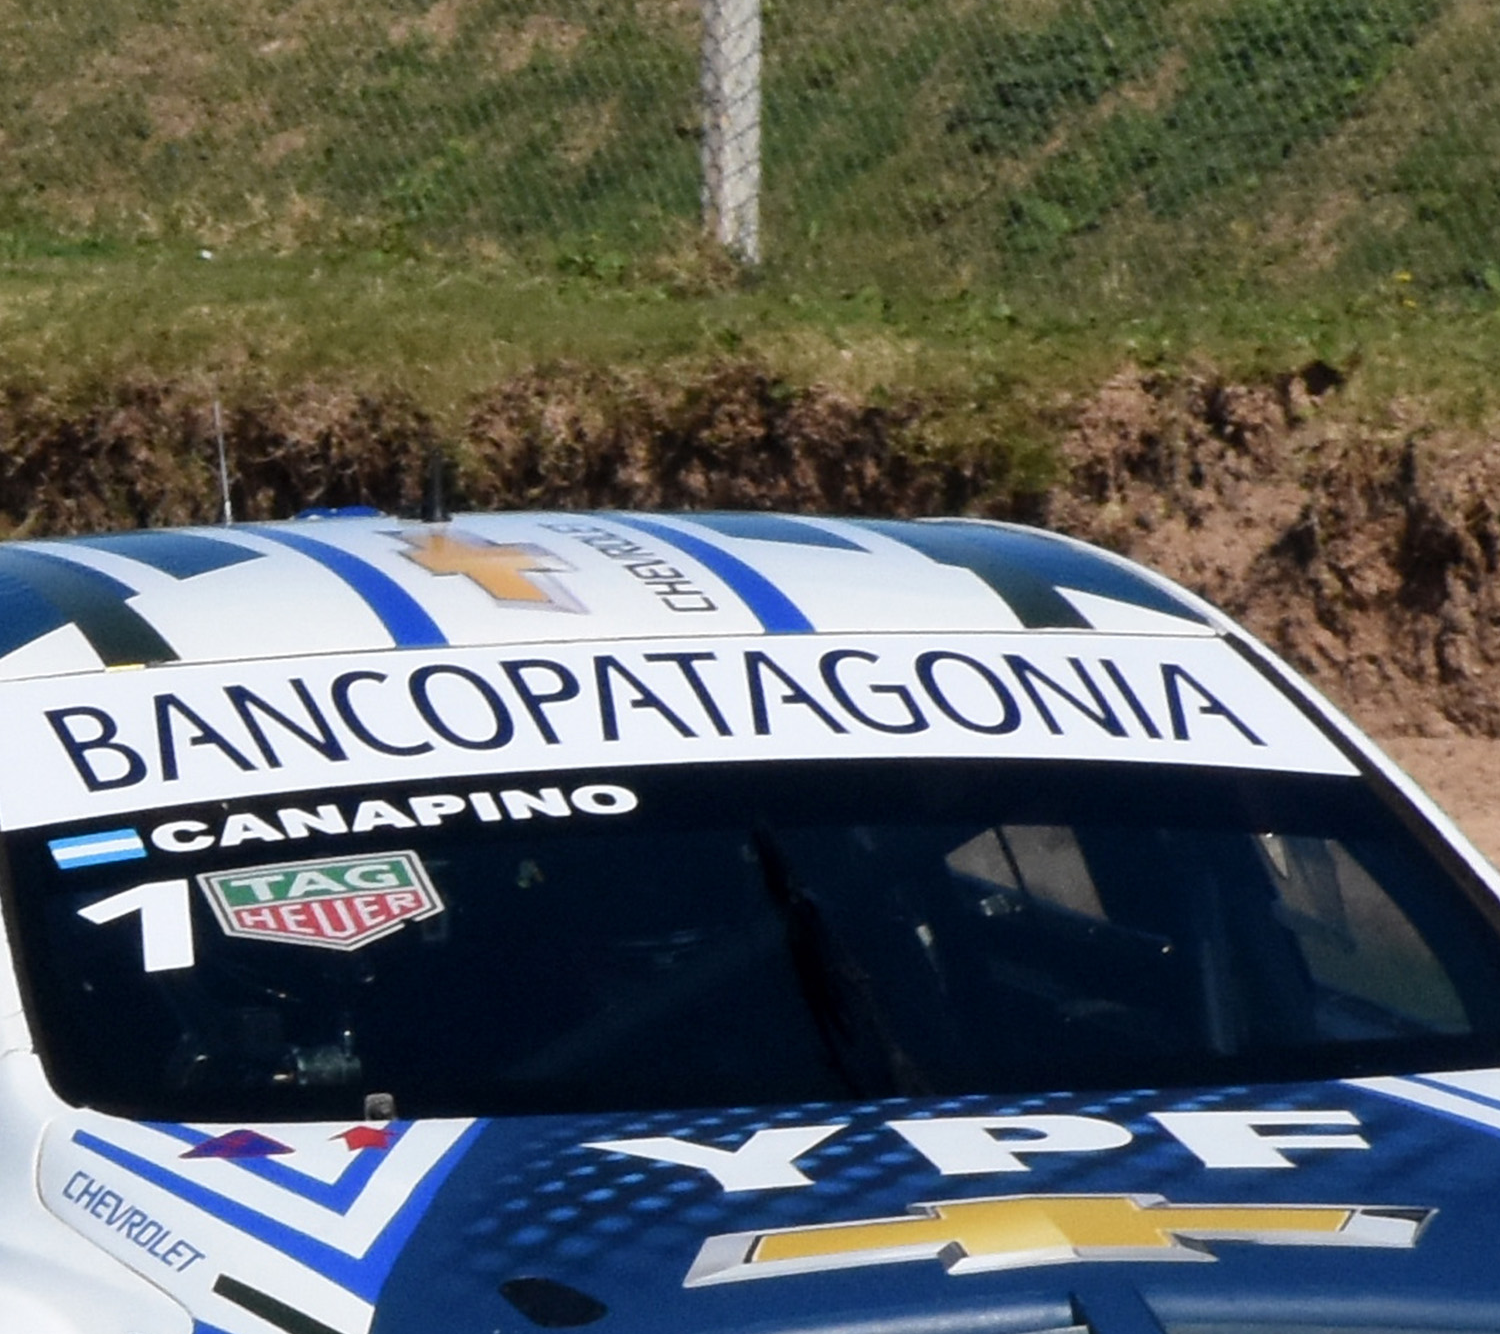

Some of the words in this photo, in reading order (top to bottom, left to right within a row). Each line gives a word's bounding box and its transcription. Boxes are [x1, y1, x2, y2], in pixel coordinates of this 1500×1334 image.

[44, 648, 1268, 794] BANCOPATAGONIA
[151, 784, 639, 854] CANAPINO
[230, 864, 401, 902] TAG
[240, 892, 416, 938] HEUER
[77, 879, 195, 973] 1
[581, 1109, 1371, 1191] YPF
[62, 1171, 206, 1272] CHEVROLET
